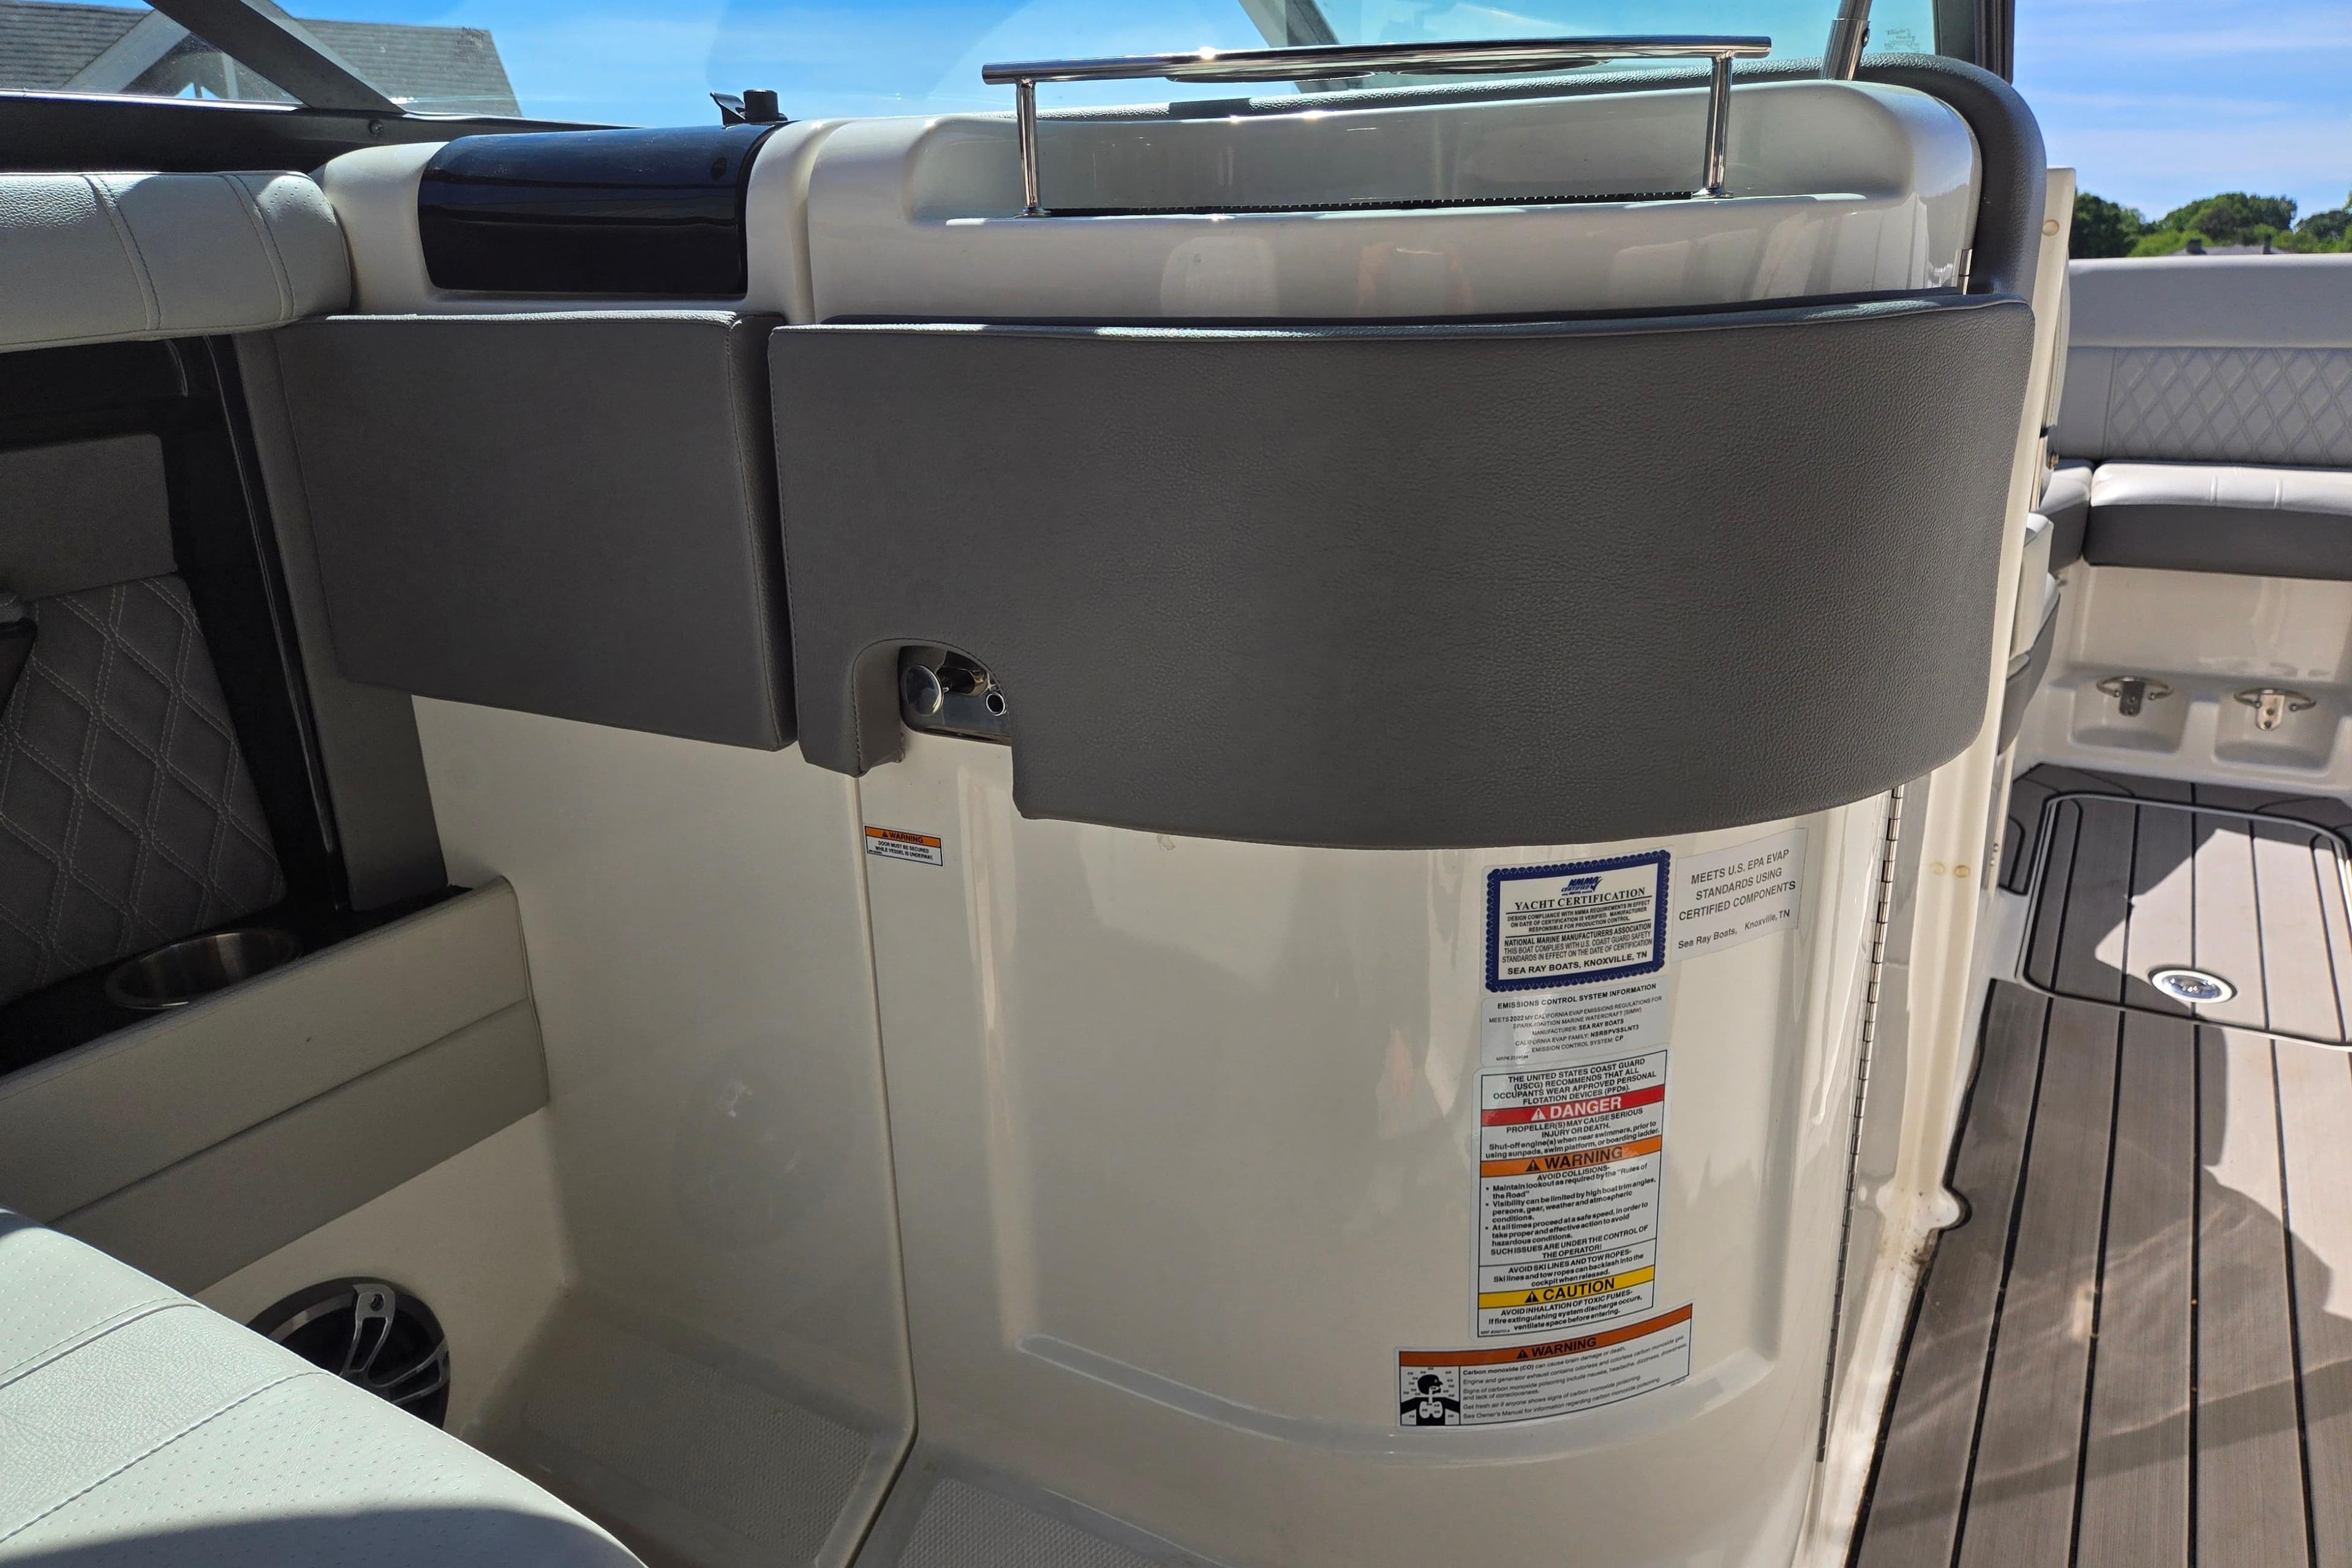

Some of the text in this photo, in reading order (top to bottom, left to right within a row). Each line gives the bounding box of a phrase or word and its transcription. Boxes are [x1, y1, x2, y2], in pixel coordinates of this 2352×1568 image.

[1691, 867, 1725, 884] MEETS
[1747, 856, 1764, 870] EPA
[1766, 848, 1789, 864] EVAP
[1695, 867, 1782, 900] STANDARDS USING
[1514, 887, 1645, 911] YACHT CERTIFICATION
[1527, 911, 1560, 919] COMPLIANCE
[1589, 903, 1626, 913] REQUIREMENTS
[1678, 880, 1796, 921] CERTIFIED COMPONENTS
[1528, 924, 1562, 932] RESPONSIBLE
[1575, 919, 1606, 927] PRODUCTION
[1541, 915, 1578, 924] CERTIFICATION
[1609, 907, 1646, 916] MANUFACTURER
[1504, 922, 1651, 946] NATIONAL MARINE MANUFACTURERS ASSOCIATION
[1678, 938, 1694, 948] Sea
[1695, 933, 1711, 945] Ray
[1713, 926, 1737, 940] Boats,
[1779, 908, 1790, 918] TN
[1502, 952, 1537, 963] STANDARDS
[1545, 949, 1567, 959] EFFECT
[1613, 938, 1652, 950] CERTIFICATION
[1534, 942, 1564, 951] COMPLIES
[1591, 936, 1610, 945] COAST
[1611, 933, 1630, 943] GUARD
[1630, 930, 1651, 940] SAFETY
[1507, 966, 1526, 974] SEA
[1528, 963, 1546, 973] RAY
[1497, 982, 1656, 1009] EMISSIONS CONTROL SYSTEM INFORMATION
[1534, 1011, 1568, 1020] CALIFORNIA
[1583, 1005, 1613, 1014] EMISSIONS
[1614, 998, 1651, 1009] REGULATIONS
[1561, 1016, 1583, 1025] MARINE
[1585, 1011, 1622, 1022] WATERCRAFT
[1604, 1018, 1624, 1027] BOATS
[1561, 1041, 1588, 1049] CONTROL
[1508, 1057, 1645, 1084] THE UNITED STATES COAST GUARD
[1513, 1066, 1639, 1091] (USCG) RECOMMENDS THAT ALL
[1493, 1069, 1657, 1100] OCCUPANTS WEAR APPROVED PERSONAL
[1522, 1094, 1567, 1106] FLOTATION
[1569, 1088, 1603, 1101] DEVICES
[1550, 1095, 1621, 1119] DANGER
[1506, 1107, 1643, 1134] PROPELLER(S) MAY CAUSE SERIOUS
[1541, 1121, 1610, 1139] INJURY OR DEATH.
[1520, 1139, 1556, 1149] engine(s)
[1556, 1136, 1577, 1144] when
[1594, 1126, 1632, 1139] swimmers,
[1632, 1121, 1649, 1132] prior
[1545, 1145, 1623, 1170] WARNING
[1537, 1172, 1561, 1182] AVOID
[1542, 1276, 1615, 1302] CAUTION
[1501, 1308, 1525, 1316] AVOID
[1525, 1302, 1572, 1315] INHALATION
[1572, 1300, 1583, 1309] OF
[1584, 1295, 1605, 1306] TOXIC
[1531, 1336, 1597, 1358] WARNING
[1487, 1365, 1518, 1374] monoxide
[1580, 1350, 1602, 1362] damage
